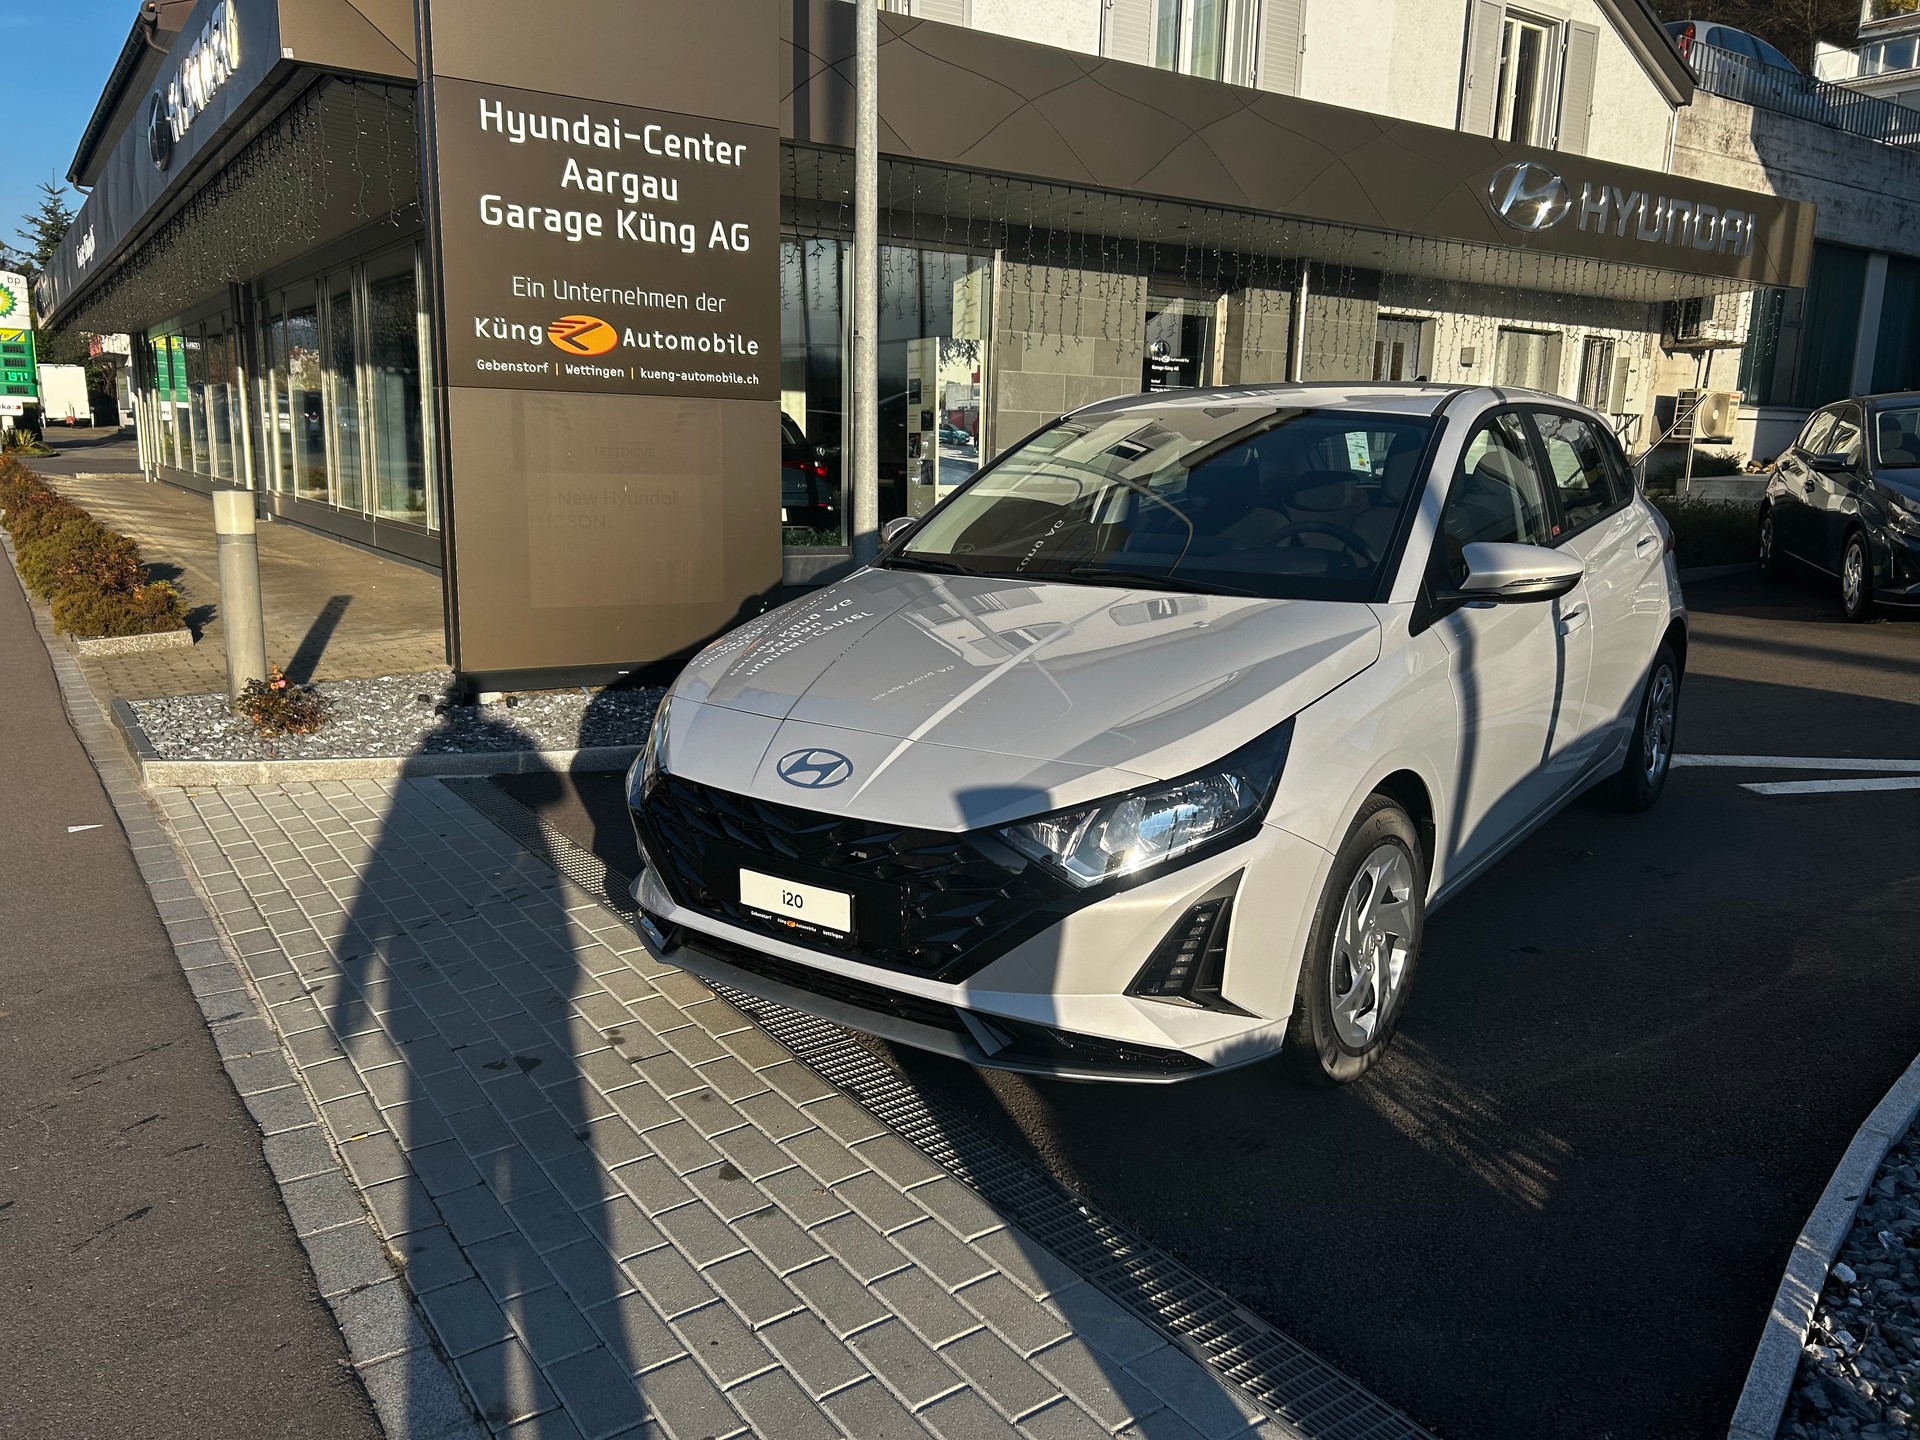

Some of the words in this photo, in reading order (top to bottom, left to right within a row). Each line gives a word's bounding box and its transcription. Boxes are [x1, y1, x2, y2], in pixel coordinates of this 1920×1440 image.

[478, 97, 747, 166] Hyundai-Center
[560, 158, 679, 204] Aargau
[479, 194, 603, 242] Garage
[616, 208, 696, 254] Küng
[707, 220, 750, 252] AG
[1578, 181, 1757, 258] HYUNDAI
[7, 275, 20, 285] bp
[512, 276, 545, 299] Ein
[553, 280, 688, 311] Unternehmen
[695, 292, 727, 313] der
[474, 317, 543, 345] Küng
[622, 327, 760, 356] Automobile
[476, 359, 549, 374] Gebenstorf
[565, 363, 625, 378] Wettingen
[640, 367, 760, 385] kueng-automobile.ch
[782, 890, 804, 908] i20
